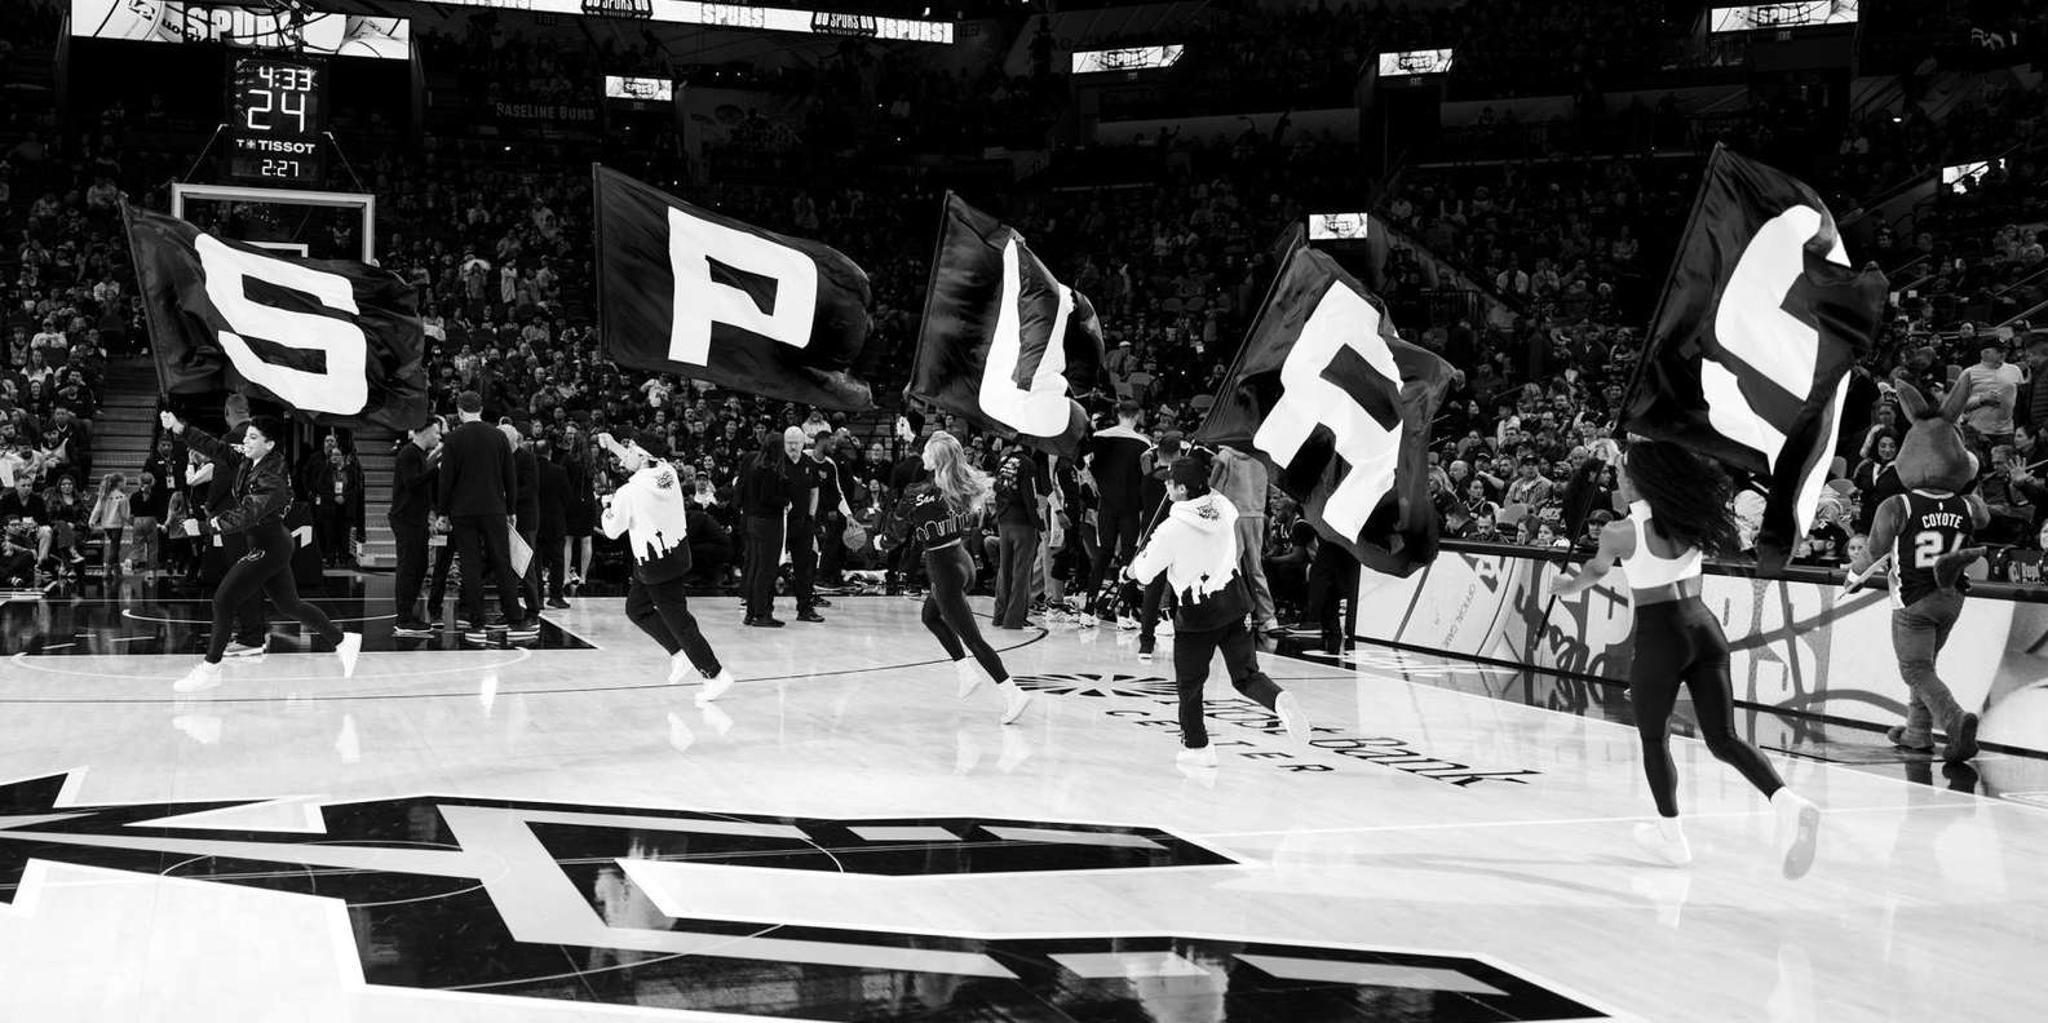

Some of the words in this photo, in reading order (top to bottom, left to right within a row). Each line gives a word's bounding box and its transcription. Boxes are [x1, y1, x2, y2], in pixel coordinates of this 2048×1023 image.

[702, 3, 764, 27] SPURS
[883, 17, 946, 42] SPURS
[259, 66, 312, 91] 4:33
[248, 89, 306, 132] 24
[257, 140, 316, 154] TISSOT
[261, 159, 299, 177] 2:27
[667, 205, 818, 367] P
[194, 232, 368, 415] S
[1252, 279, 1405, 544] R
[1921, 512, 1964, 529] COYOTE
[1307, 737, 1544, 789] Bank
